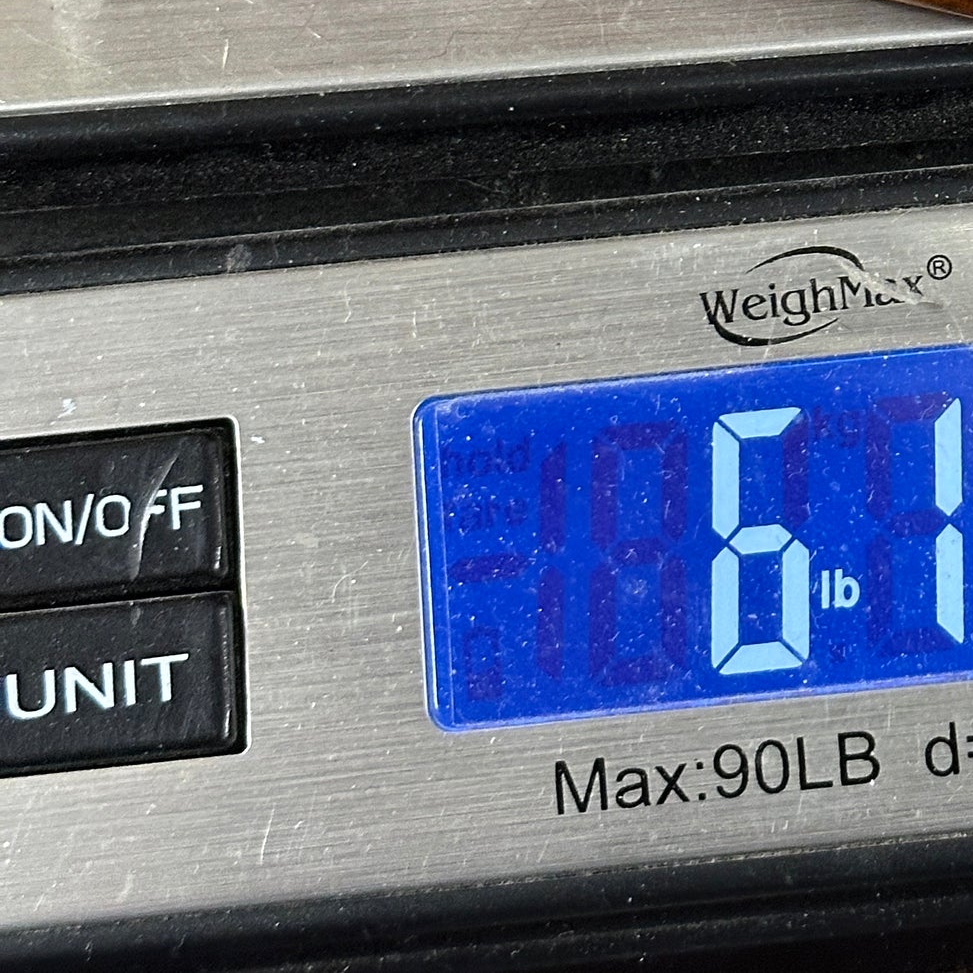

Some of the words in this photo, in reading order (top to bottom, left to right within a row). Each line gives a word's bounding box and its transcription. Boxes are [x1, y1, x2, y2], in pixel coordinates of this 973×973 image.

[0, 484, 204, 549] ON/OFF
[821, 568, 860, 609] lb
[5, 652, 189, 721] UNIT
[555, 730, 881, 815] Max:90LB
